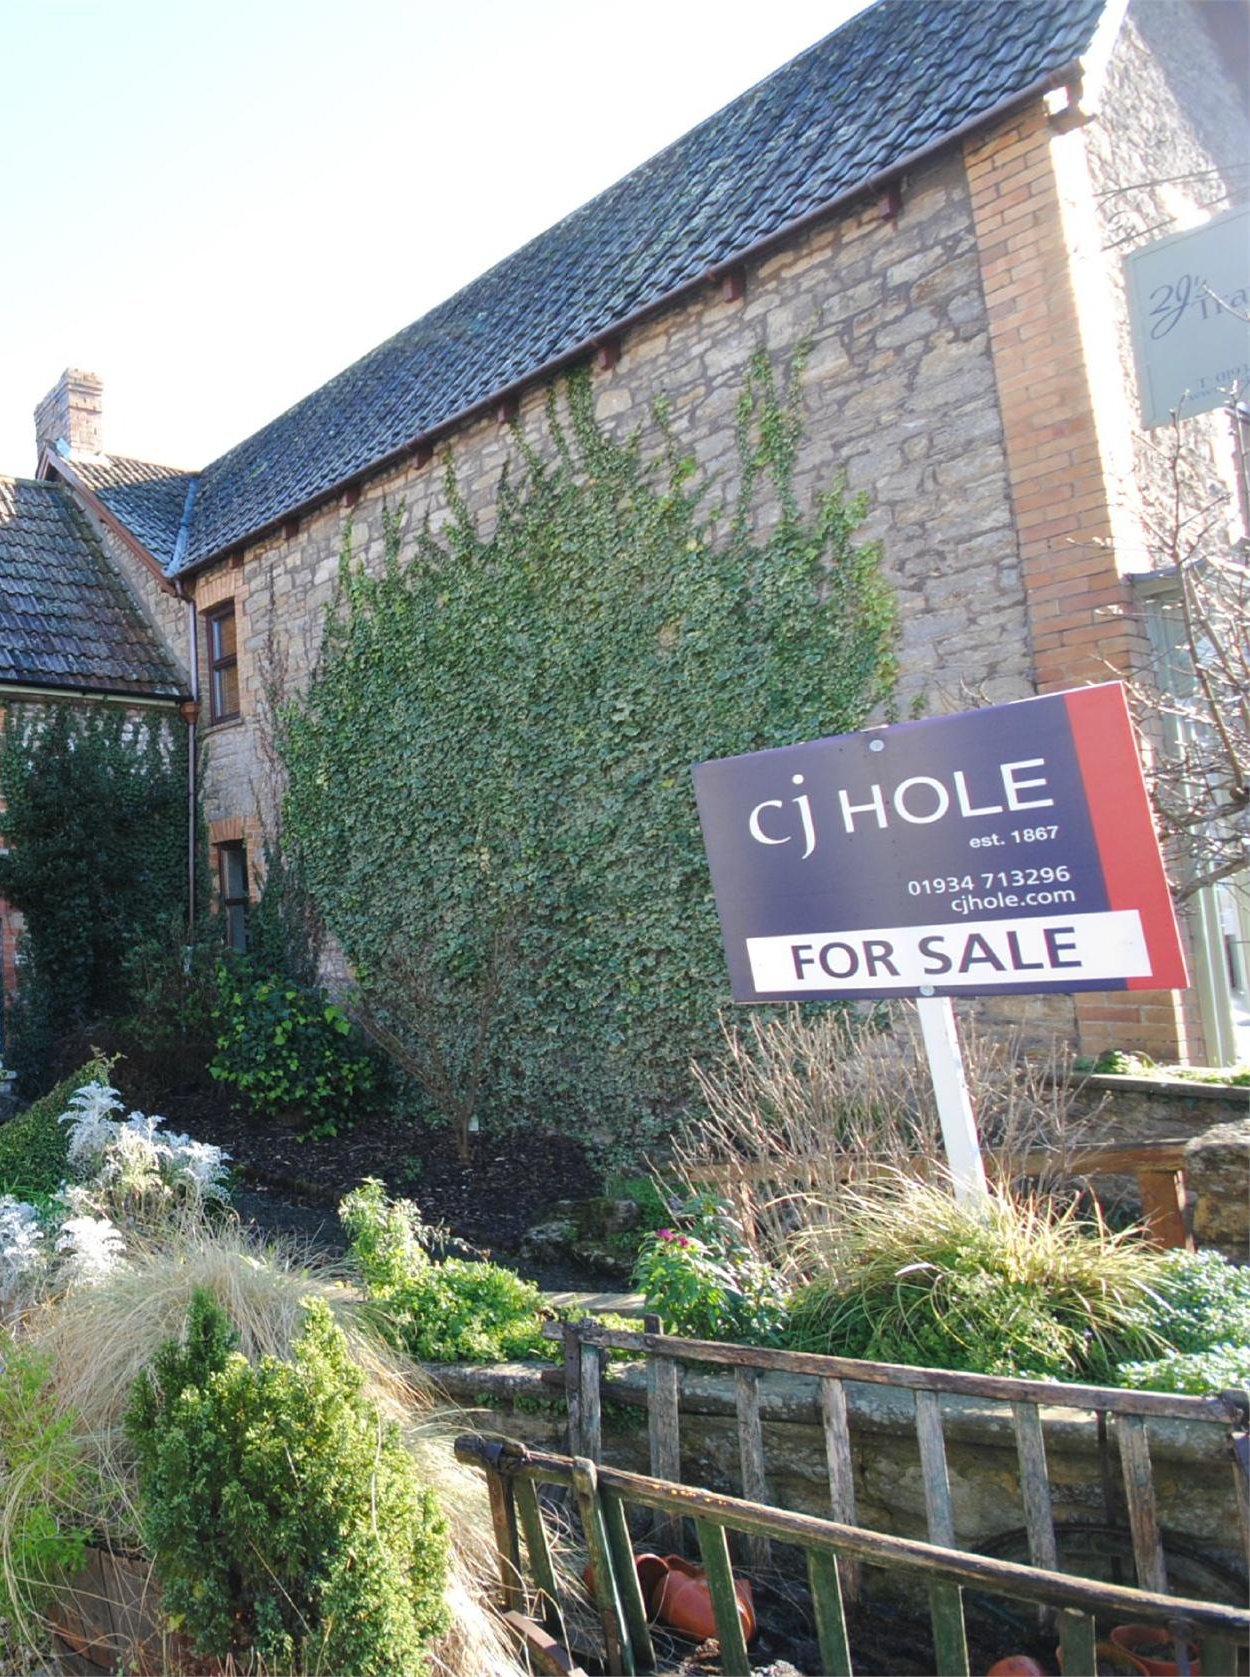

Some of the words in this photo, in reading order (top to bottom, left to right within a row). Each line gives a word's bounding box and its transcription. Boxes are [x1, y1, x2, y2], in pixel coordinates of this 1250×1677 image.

[748, 774, 817, 859] cj
[839, 758, 1054, 834] HOLE
[969, 833, 1005, 850] est.
[1011, 825, 1059, 844] 1867
[908, 873, 974, 897] 01934
[981, 864, 1071, 890] 713296
[951, 888, 1076, 914] cjhole.com
[791, 939, 900, 980] FOR
[918, 926, 1082, 975] SALE
